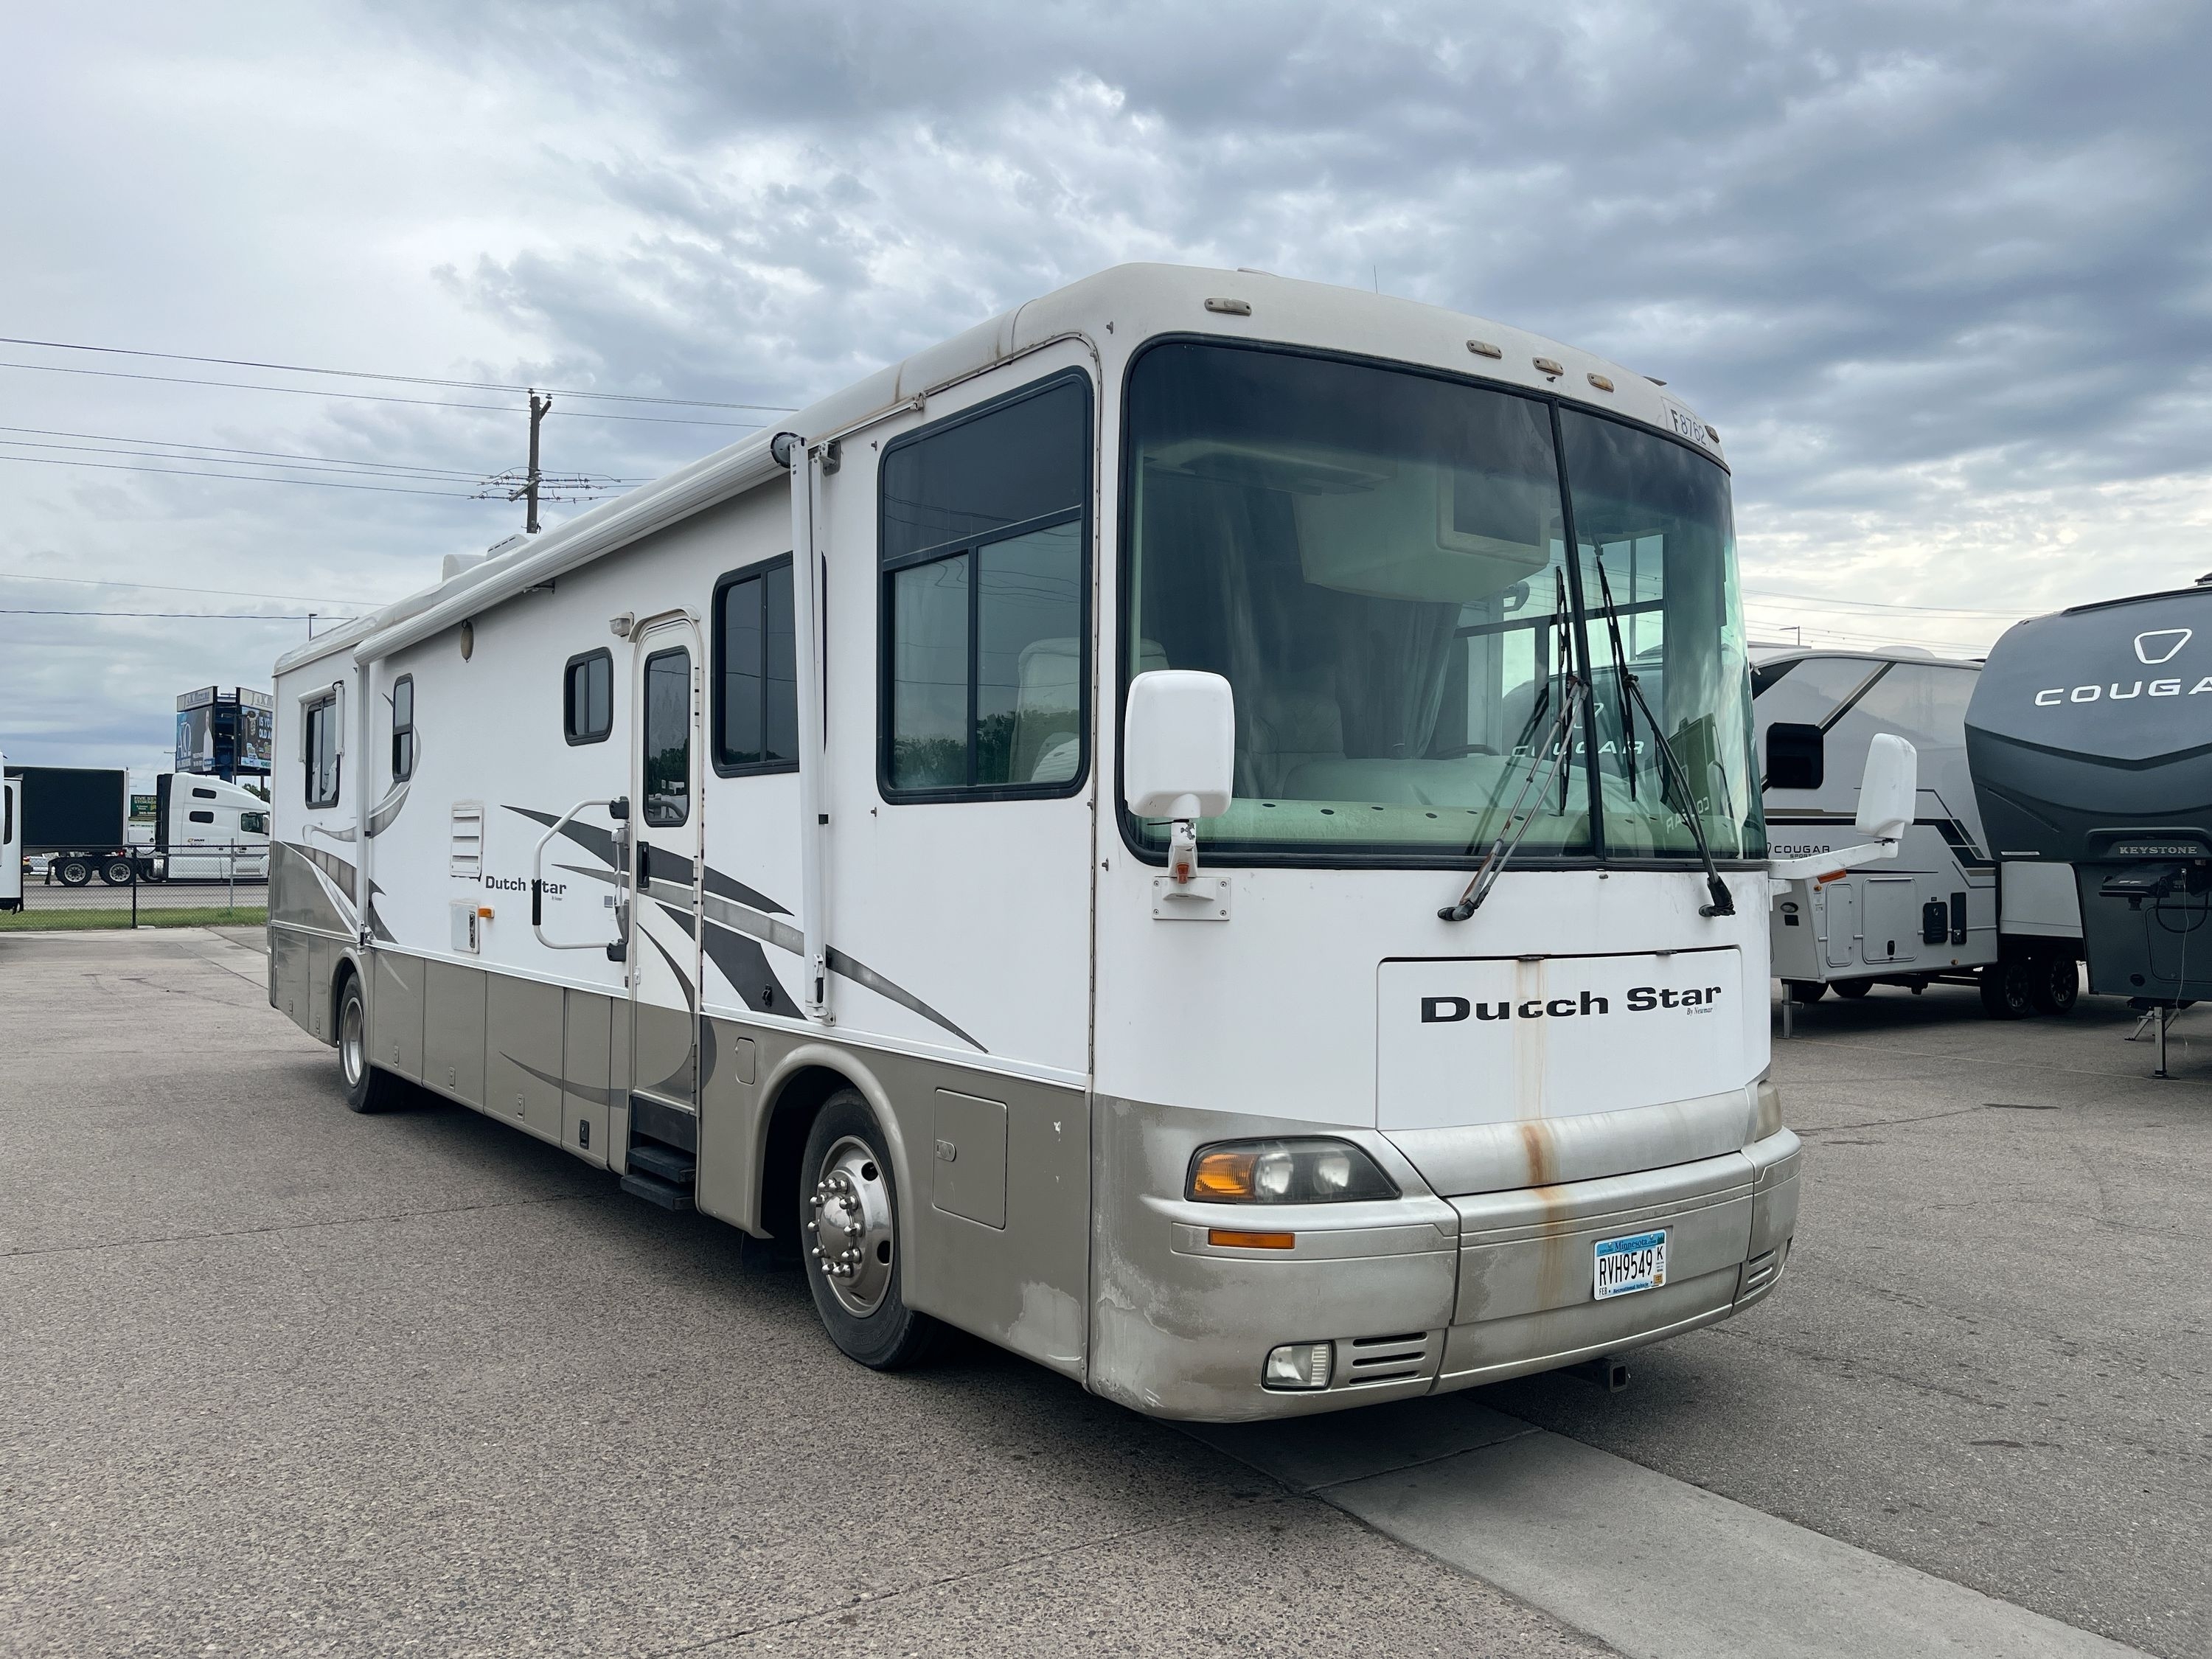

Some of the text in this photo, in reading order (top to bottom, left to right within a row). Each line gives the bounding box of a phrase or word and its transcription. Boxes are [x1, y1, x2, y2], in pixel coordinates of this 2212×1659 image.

[1670, 408, 1707, 445] F8762
[485, 876, 567, 895] Dutch tar
[1421, 986, 1722, 1023] Dutch Star
[1657, 1245, 1663, 1261] K
[1599, 1249, 1652, 1286] RVH9549
[1599, 1287, 1607, 1295] FEB
